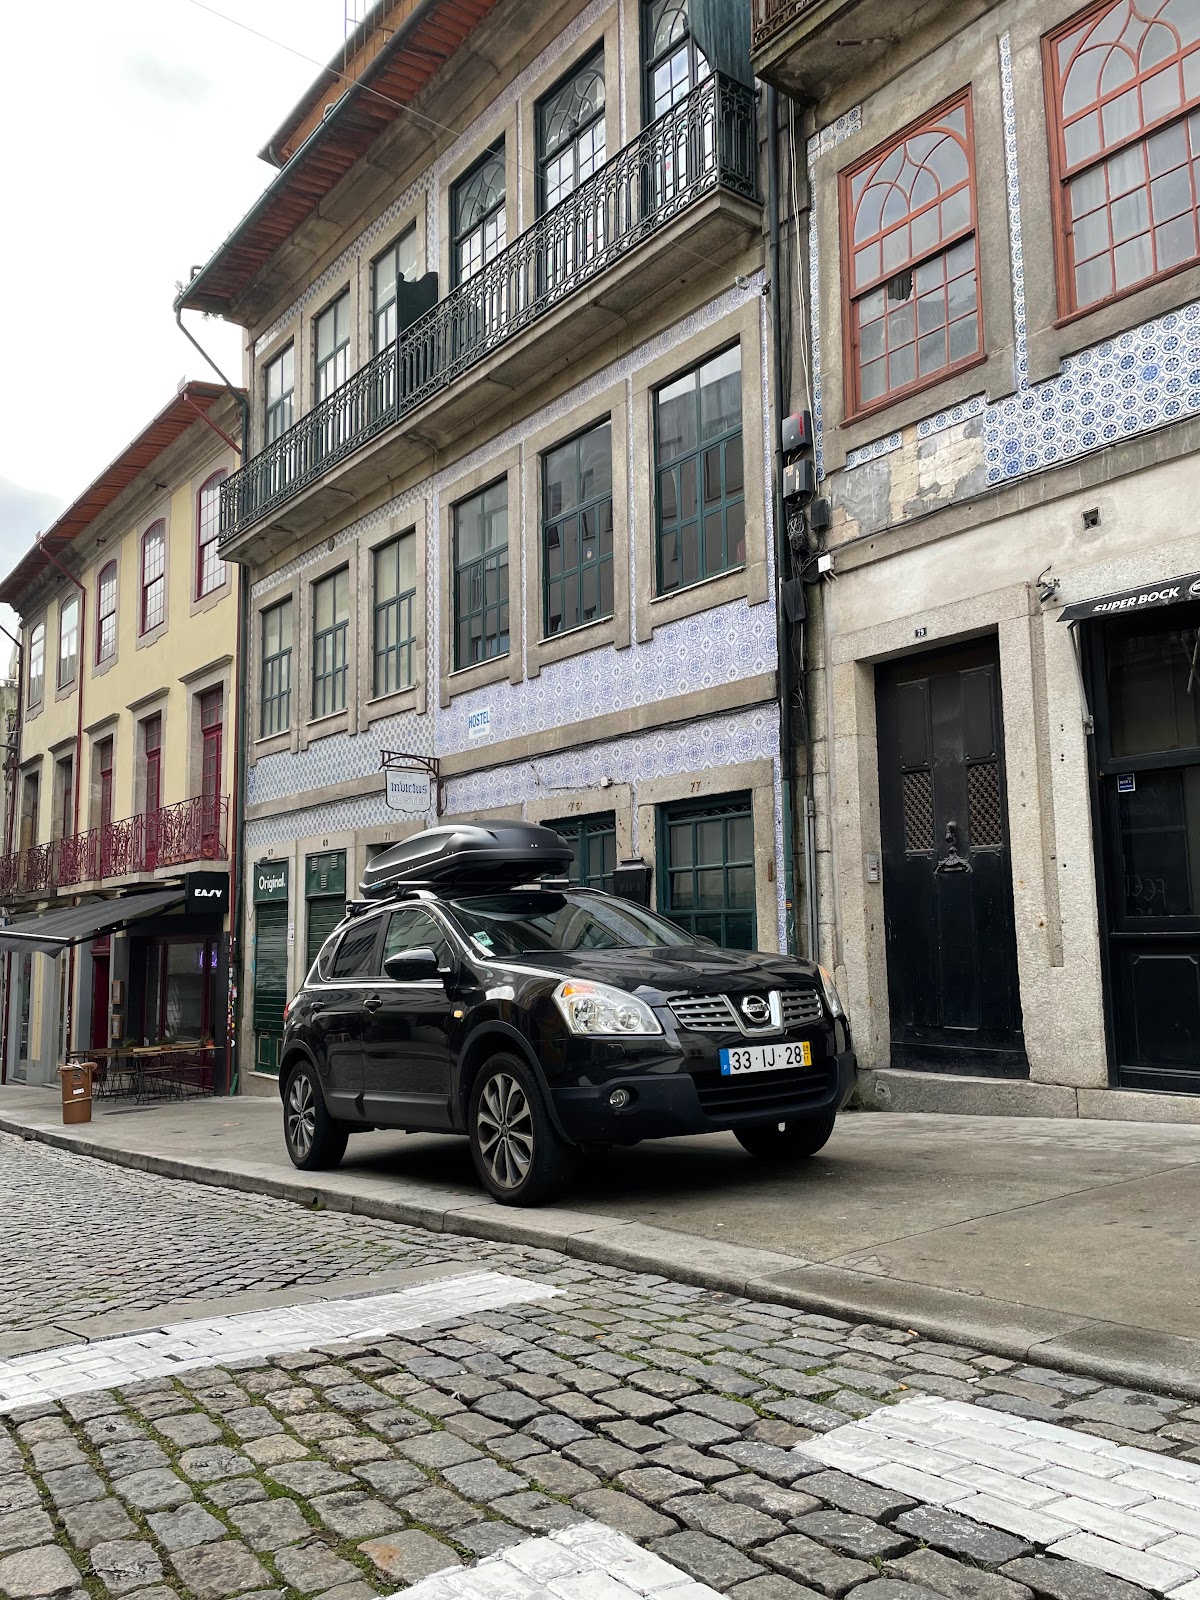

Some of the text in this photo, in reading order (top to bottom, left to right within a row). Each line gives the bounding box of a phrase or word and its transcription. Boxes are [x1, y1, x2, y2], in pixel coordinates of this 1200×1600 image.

[1092, 587, 1180, 612] SUPER BOCK
[468, 711, 489, 728] HOSTEL
[690, 782, 700, 793] 77
[390, 795, 426, 805] HOSTEL
[194, 888, 222, 898] EASY
